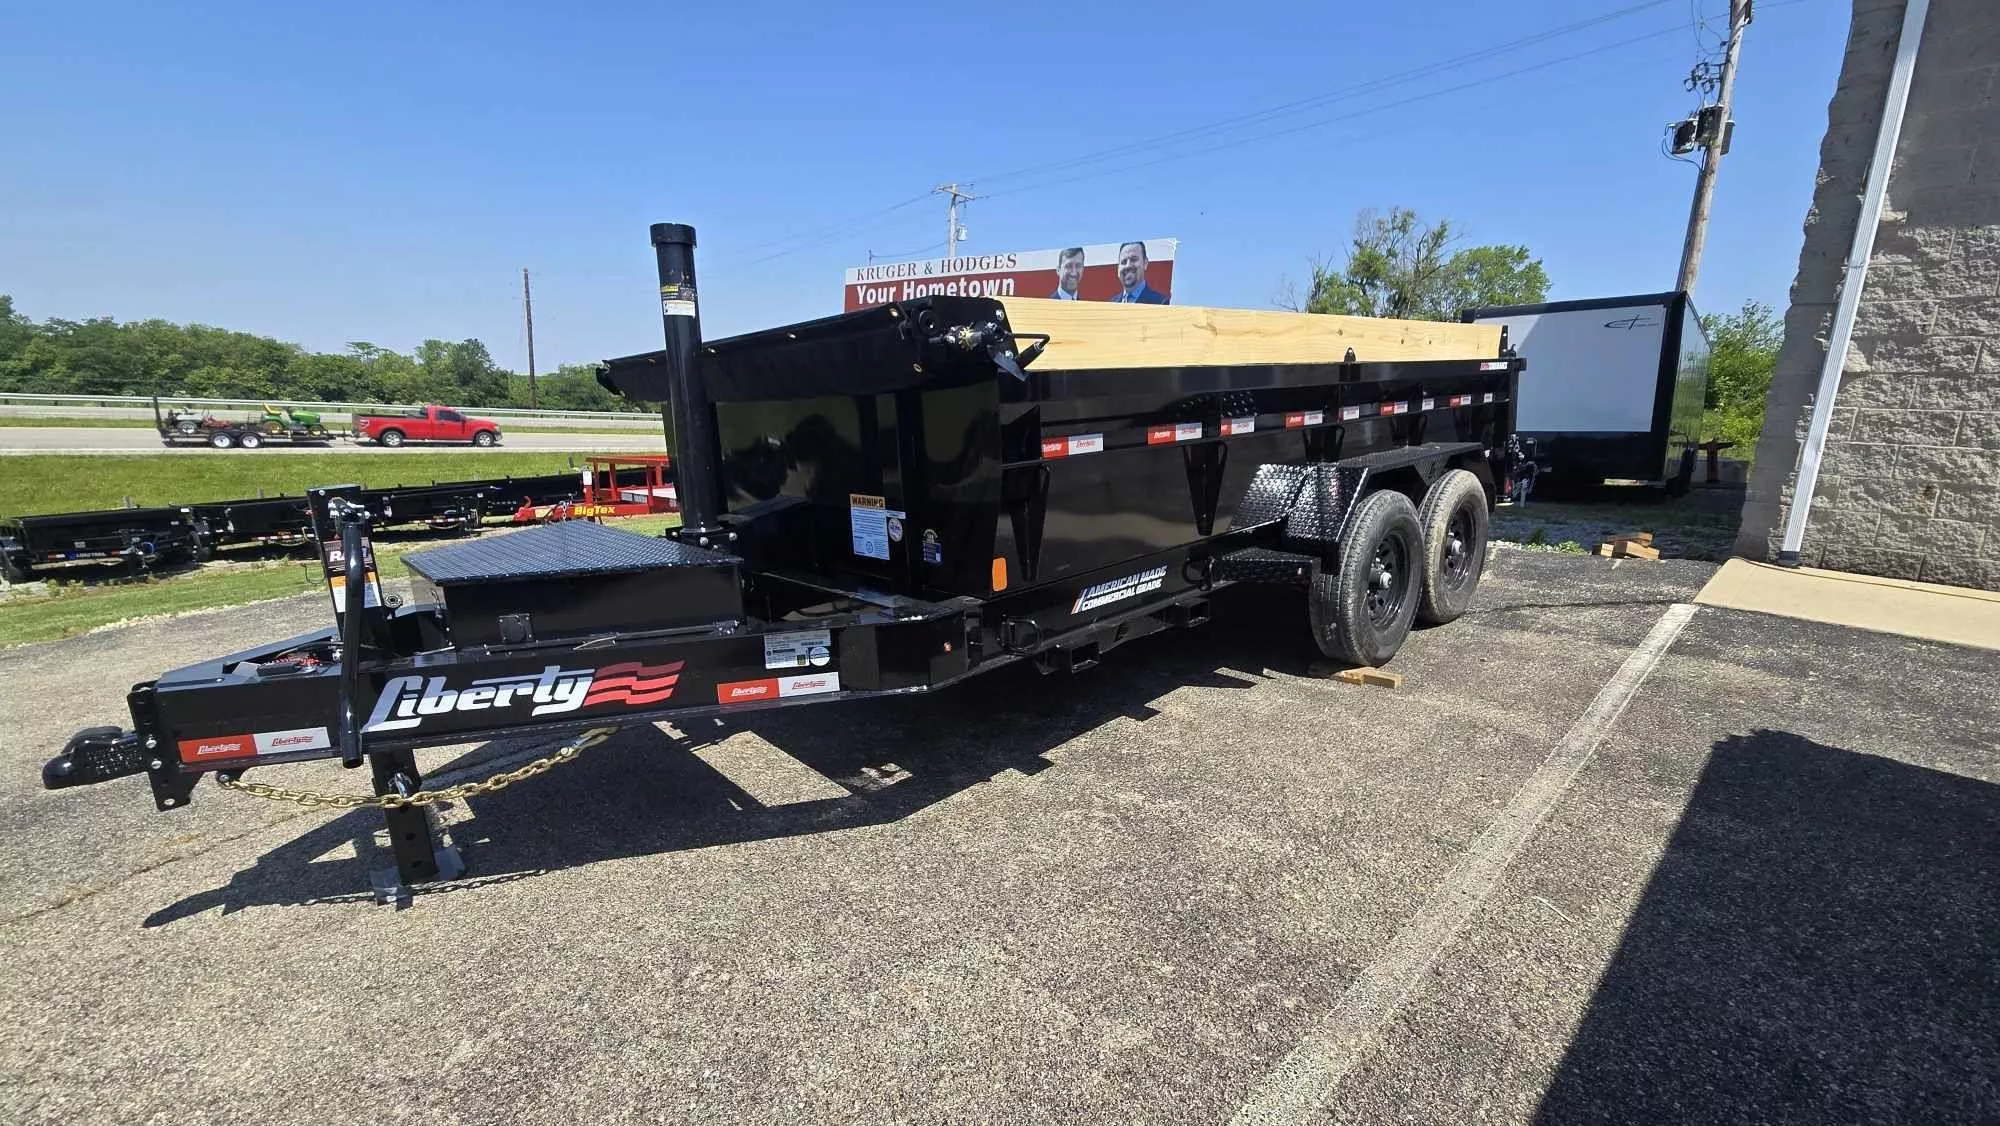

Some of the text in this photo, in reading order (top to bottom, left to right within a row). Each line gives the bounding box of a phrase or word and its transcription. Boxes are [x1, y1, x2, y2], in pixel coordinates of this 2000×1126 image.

[856, 253, 1017, 281] KRUGER & HODGES
[856, 276, 1014, 305] Your Hometown
[852, 496, 884, 507] WARNING
[1081, 578, 1162, 612] COMMERCIAL GRADE
[1087, 565, 1167, 599] AMERICAN MADE
[361, 665, 596, 734] Liberty
[196, 744, 228, 755] Liberty
[272, 736, 302, 747] Liberty
